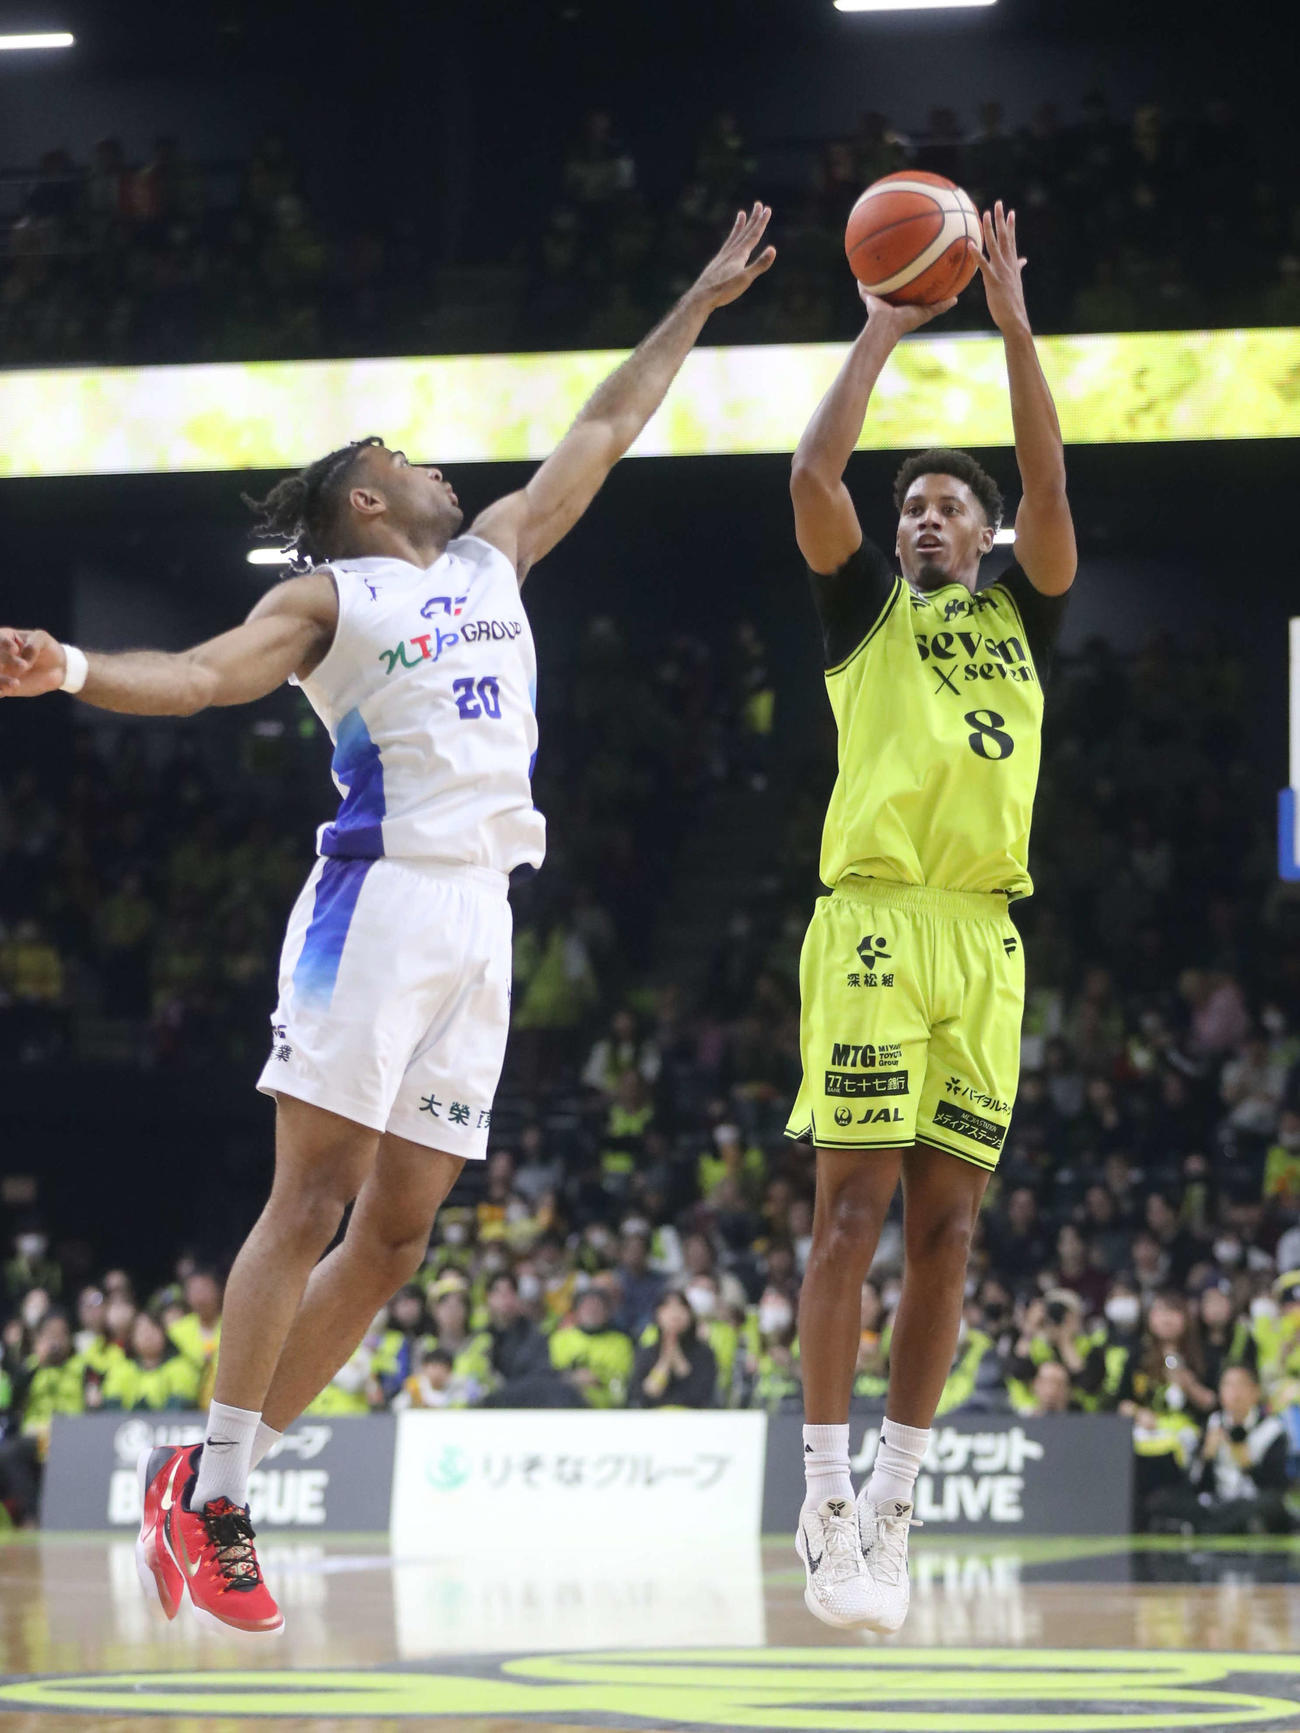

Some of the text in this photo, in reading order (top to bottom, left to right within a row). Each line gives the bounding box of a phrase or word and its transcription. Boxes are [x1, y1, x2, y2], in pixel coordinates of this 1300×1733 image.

[452, 676, 502, 720] 20
[964, 709, 1015, 760] 8
[847, 973, 895, 988] 深松組
[831, 1042, 876, 1068] MTG
[827, 1074, 906, 1093] 77 七十七銀行
[857, 1107, 904, 1124] JAL
[913, 1474, 1025, 1523] LIVE
